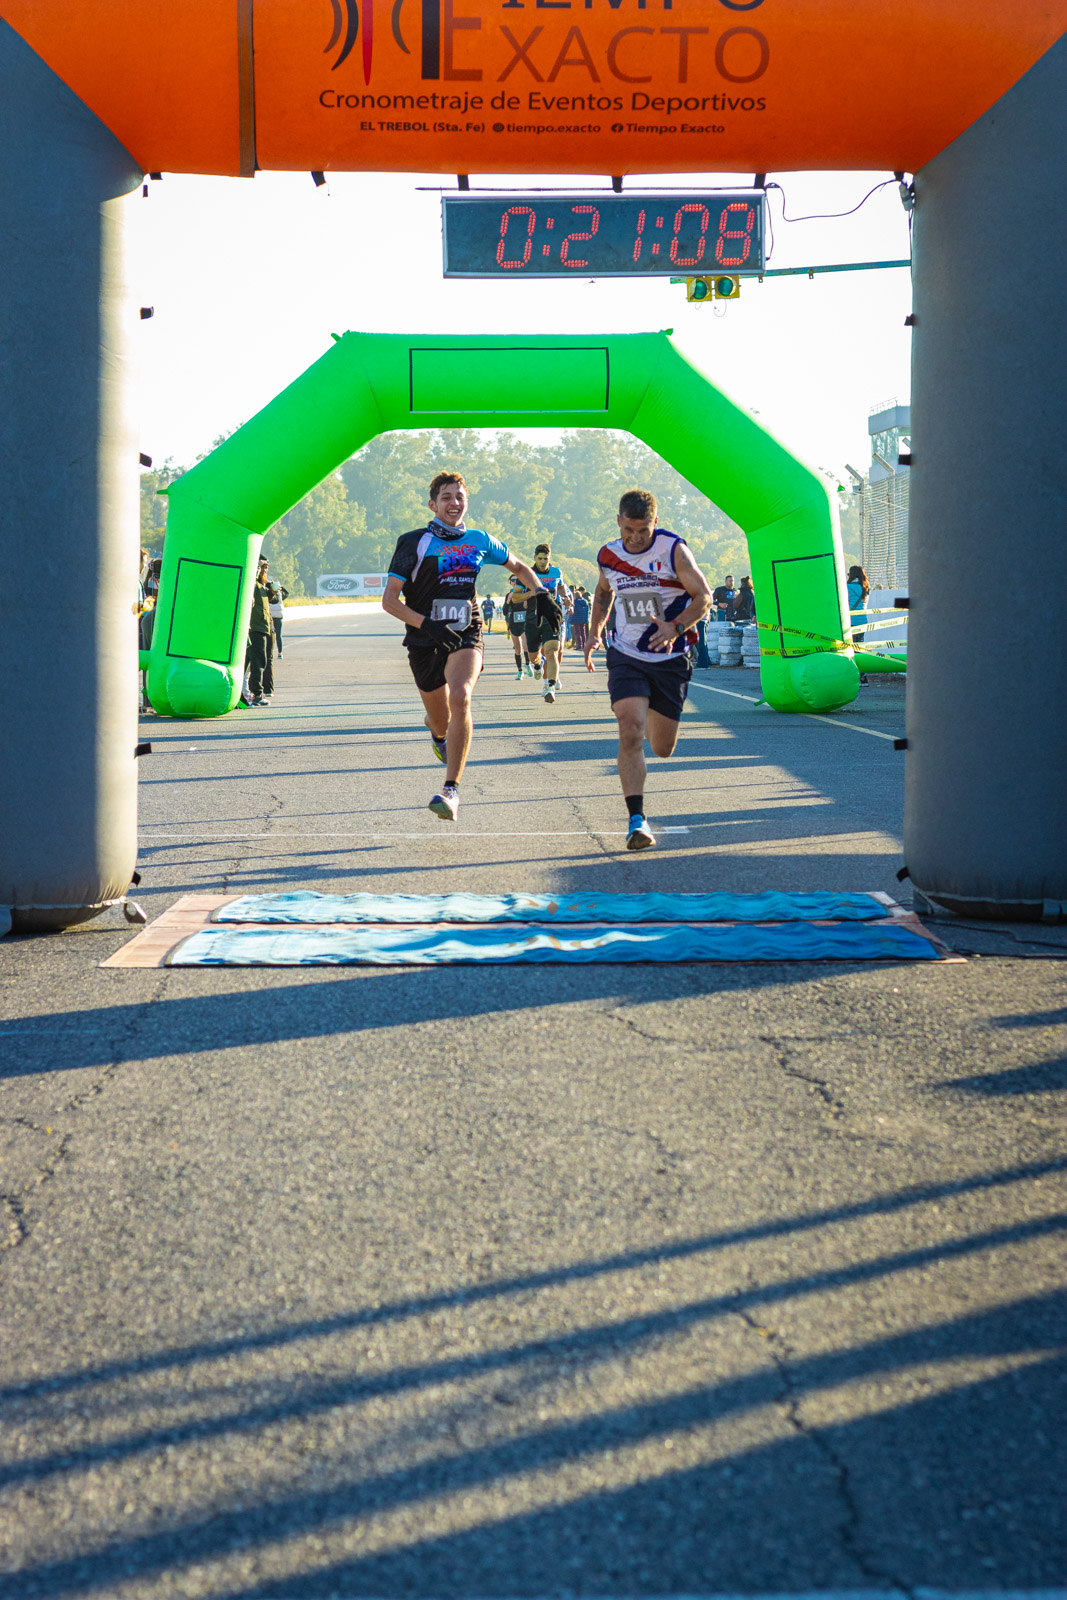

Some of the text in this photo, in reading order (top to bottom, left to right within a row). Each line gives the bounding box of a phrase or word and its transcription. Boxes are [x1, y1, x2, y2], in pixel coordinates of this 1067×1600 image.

[319, 90, 767, 115] Cronometraje de Eventos Deportivos
[360, 121, 726, 135] EL TREBOL (Sta. Fe) tiempo.exacto Tiempo Exacto
[327, 579, 351, 591] Ford
[441, 606, 466, 623] 104
[628, 599, 657, 618] 144
